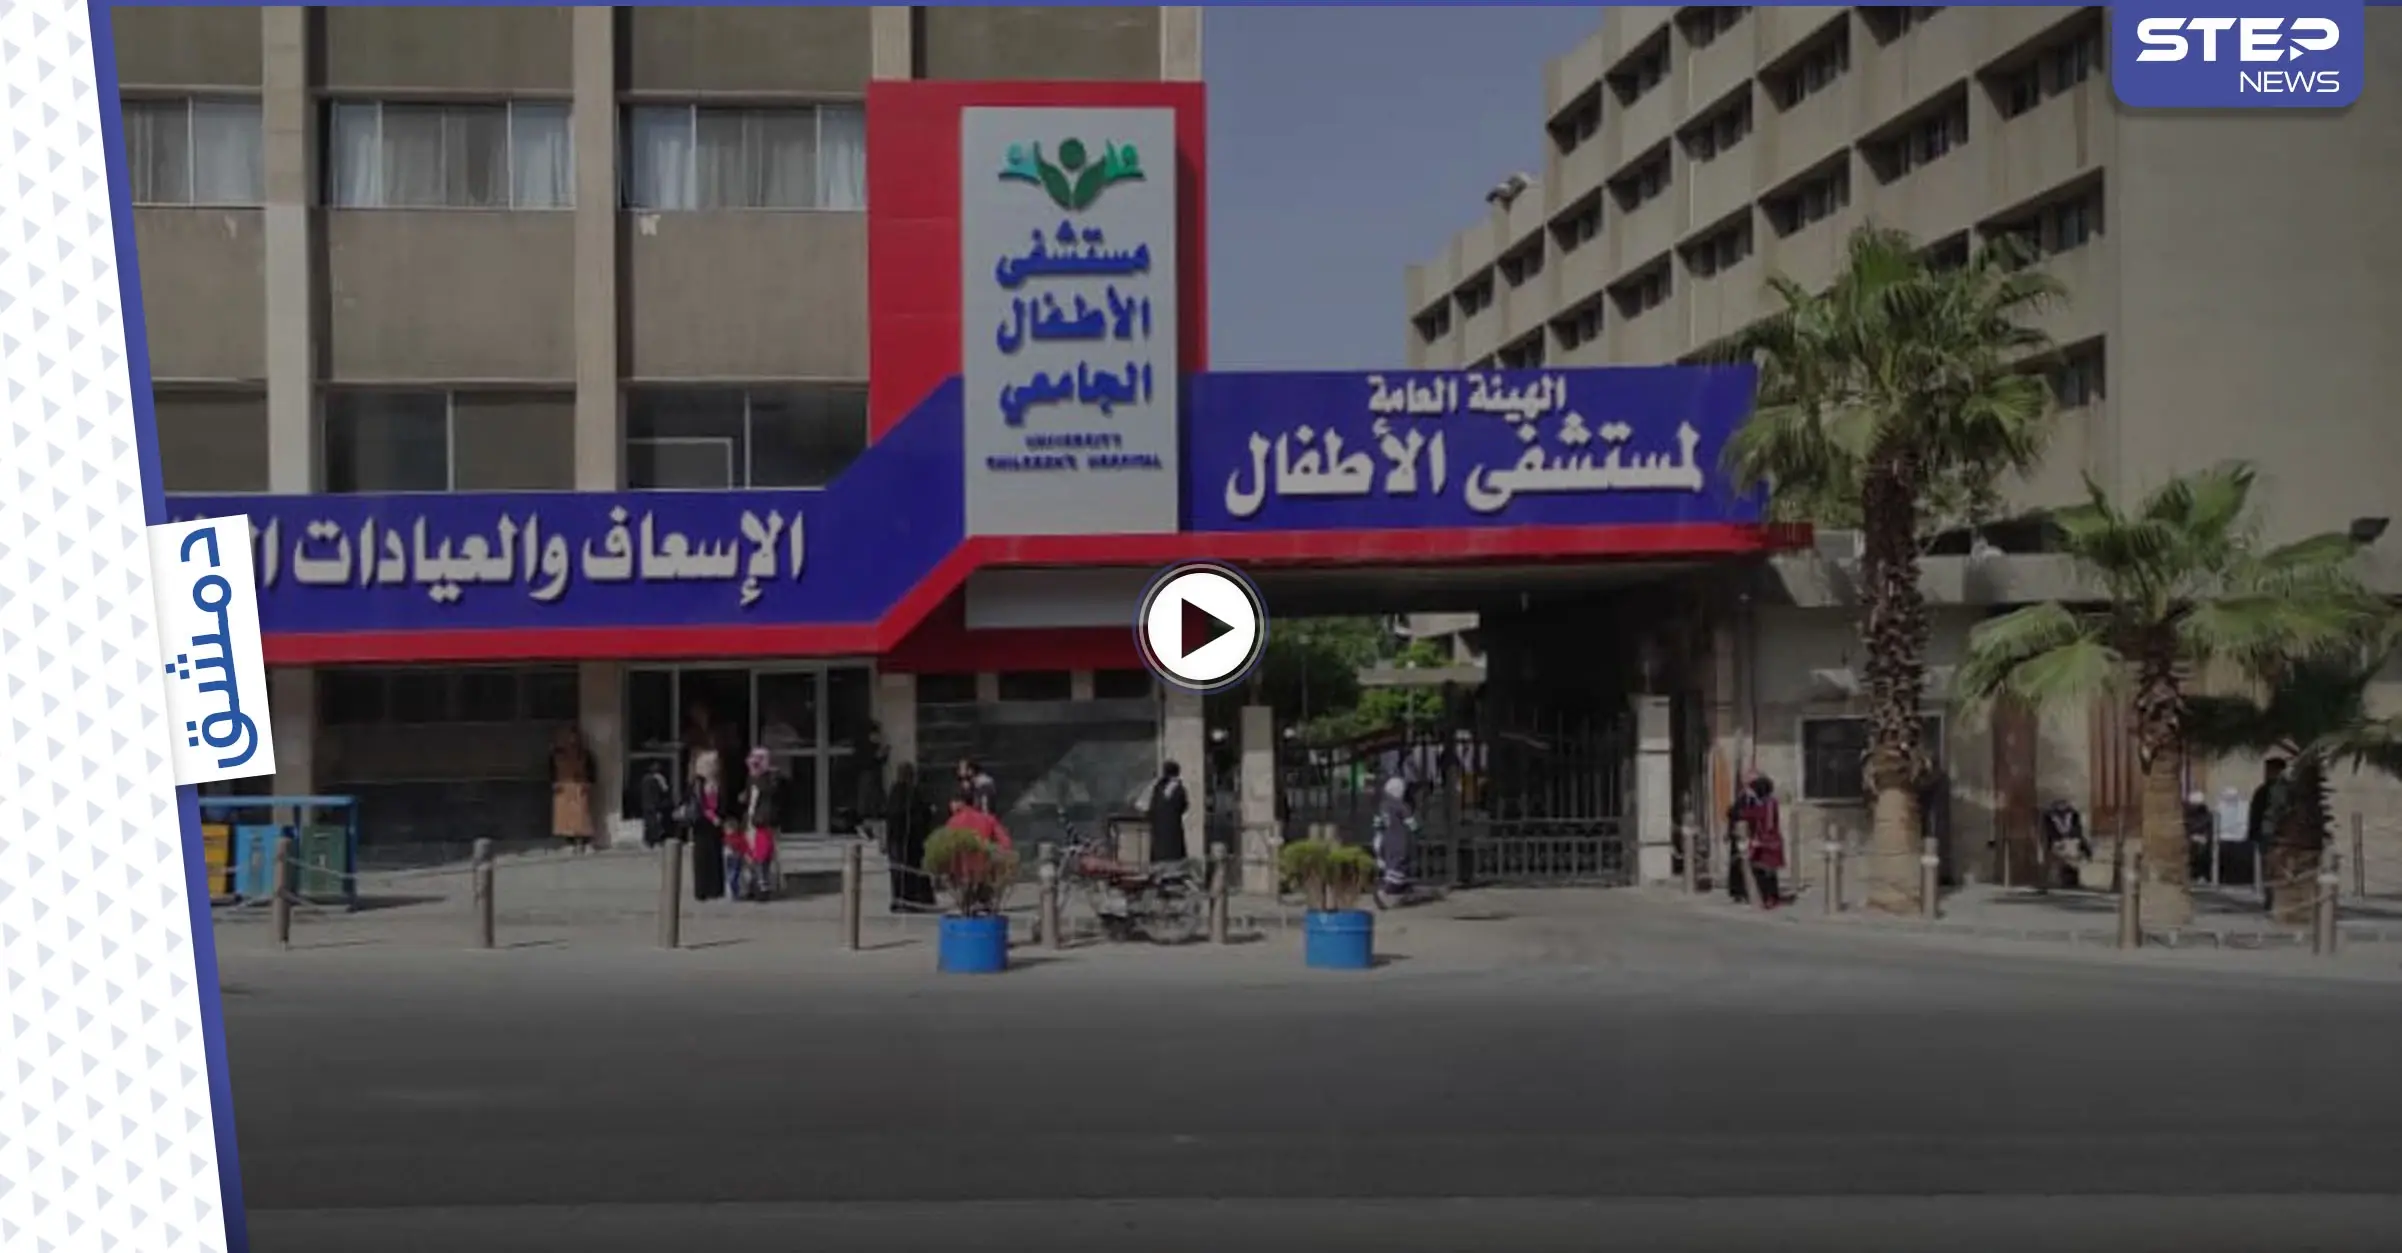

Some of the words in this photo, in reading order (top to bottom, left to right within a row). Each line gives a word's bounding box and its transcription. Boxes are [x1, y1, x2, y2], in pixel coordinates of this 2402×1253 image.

[996, 221, 1150, 289] مستشفى
[997, 285, 1151, 353] الأطفال
[1000, 360, 1152, 427] الجامعي
[1367, 374, 1458, 413] العامة
[1467, 373, 1567, 420] الهيئة
[1224, 417, 1446, 516] الأطفال
[1465, 410, 1703, 512] لمستشفى
[293, 513, 569, 602] والعيادات
[582, 507, 804, 605] الإسعاف
